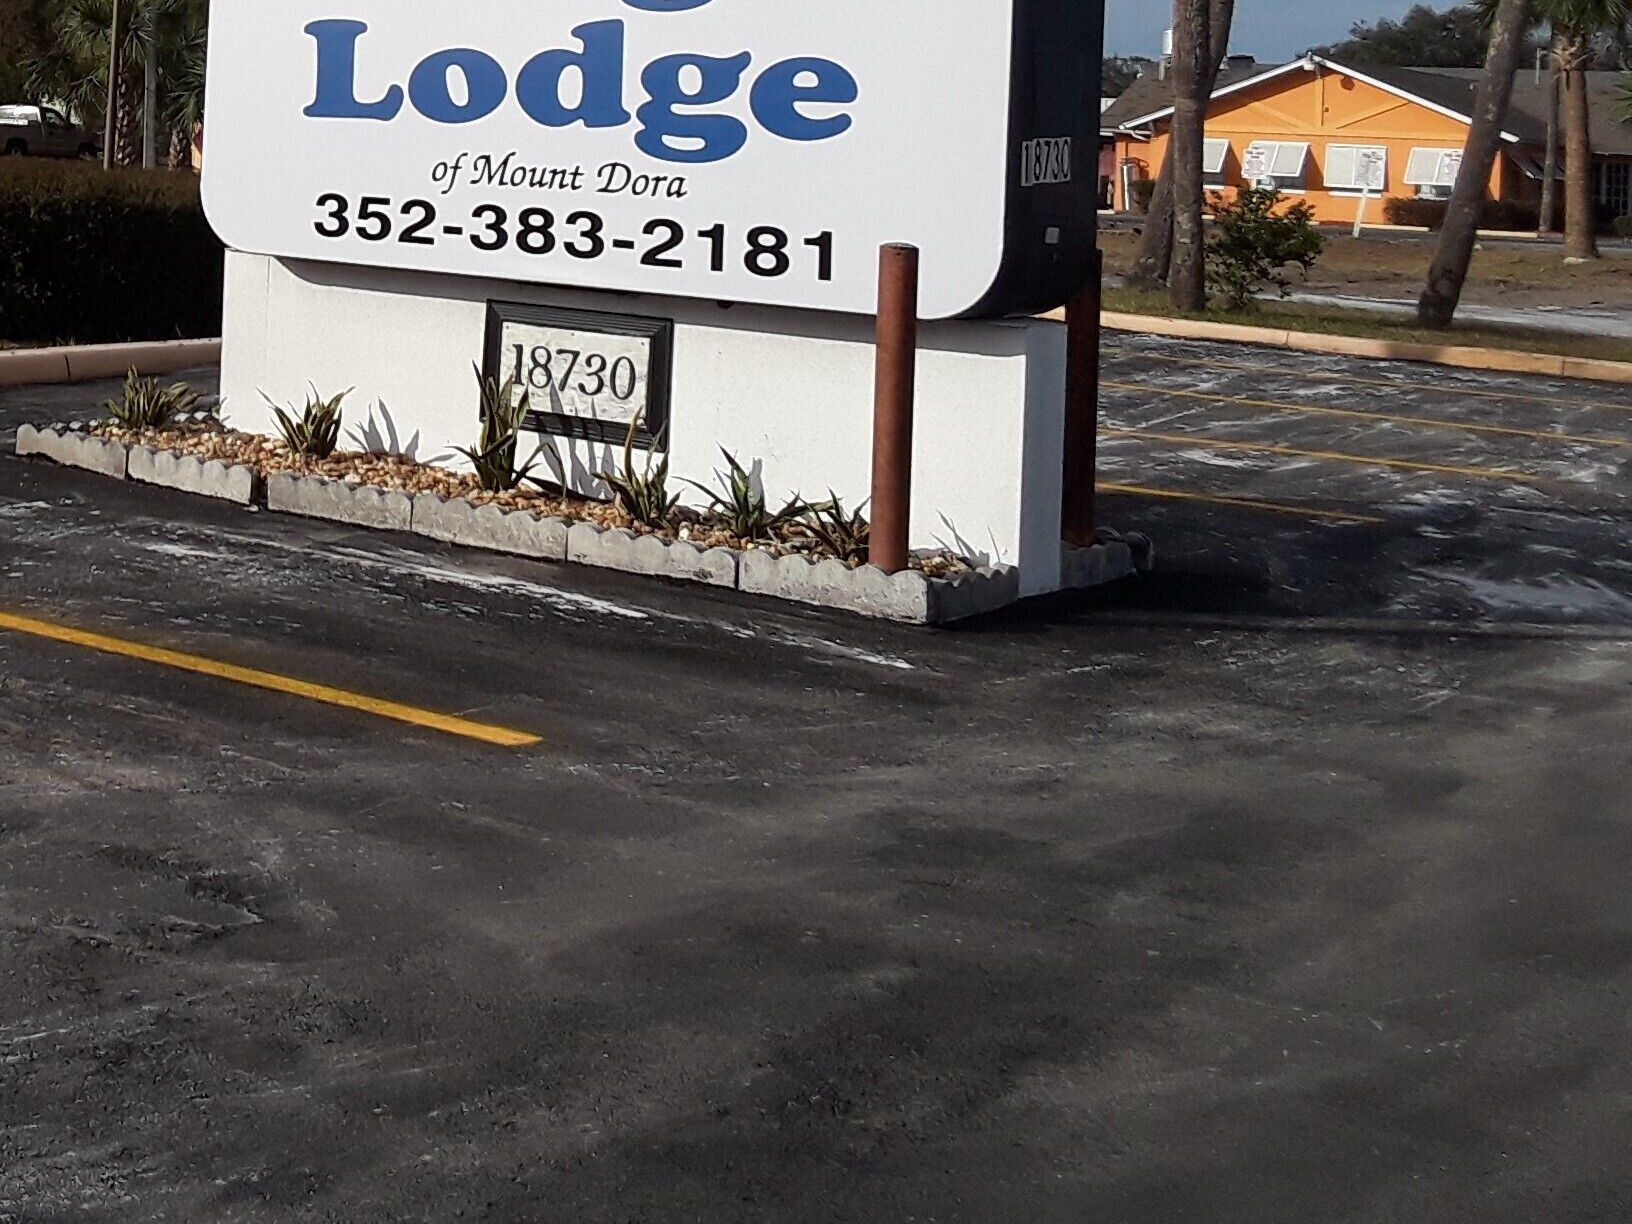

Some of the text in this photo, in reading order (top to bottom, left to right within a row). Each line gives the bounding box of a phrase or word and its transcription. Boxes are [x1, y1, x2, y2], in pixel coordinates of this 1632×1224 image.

[303, 18, 859, 165] Lodge
[430, 152, 689, 199] of Mount Dora
[1024, 138, 1069, 184] 18730
[313, 192, 834, 282] 352-383-2181
[510, 343, 637, 401] 18730
